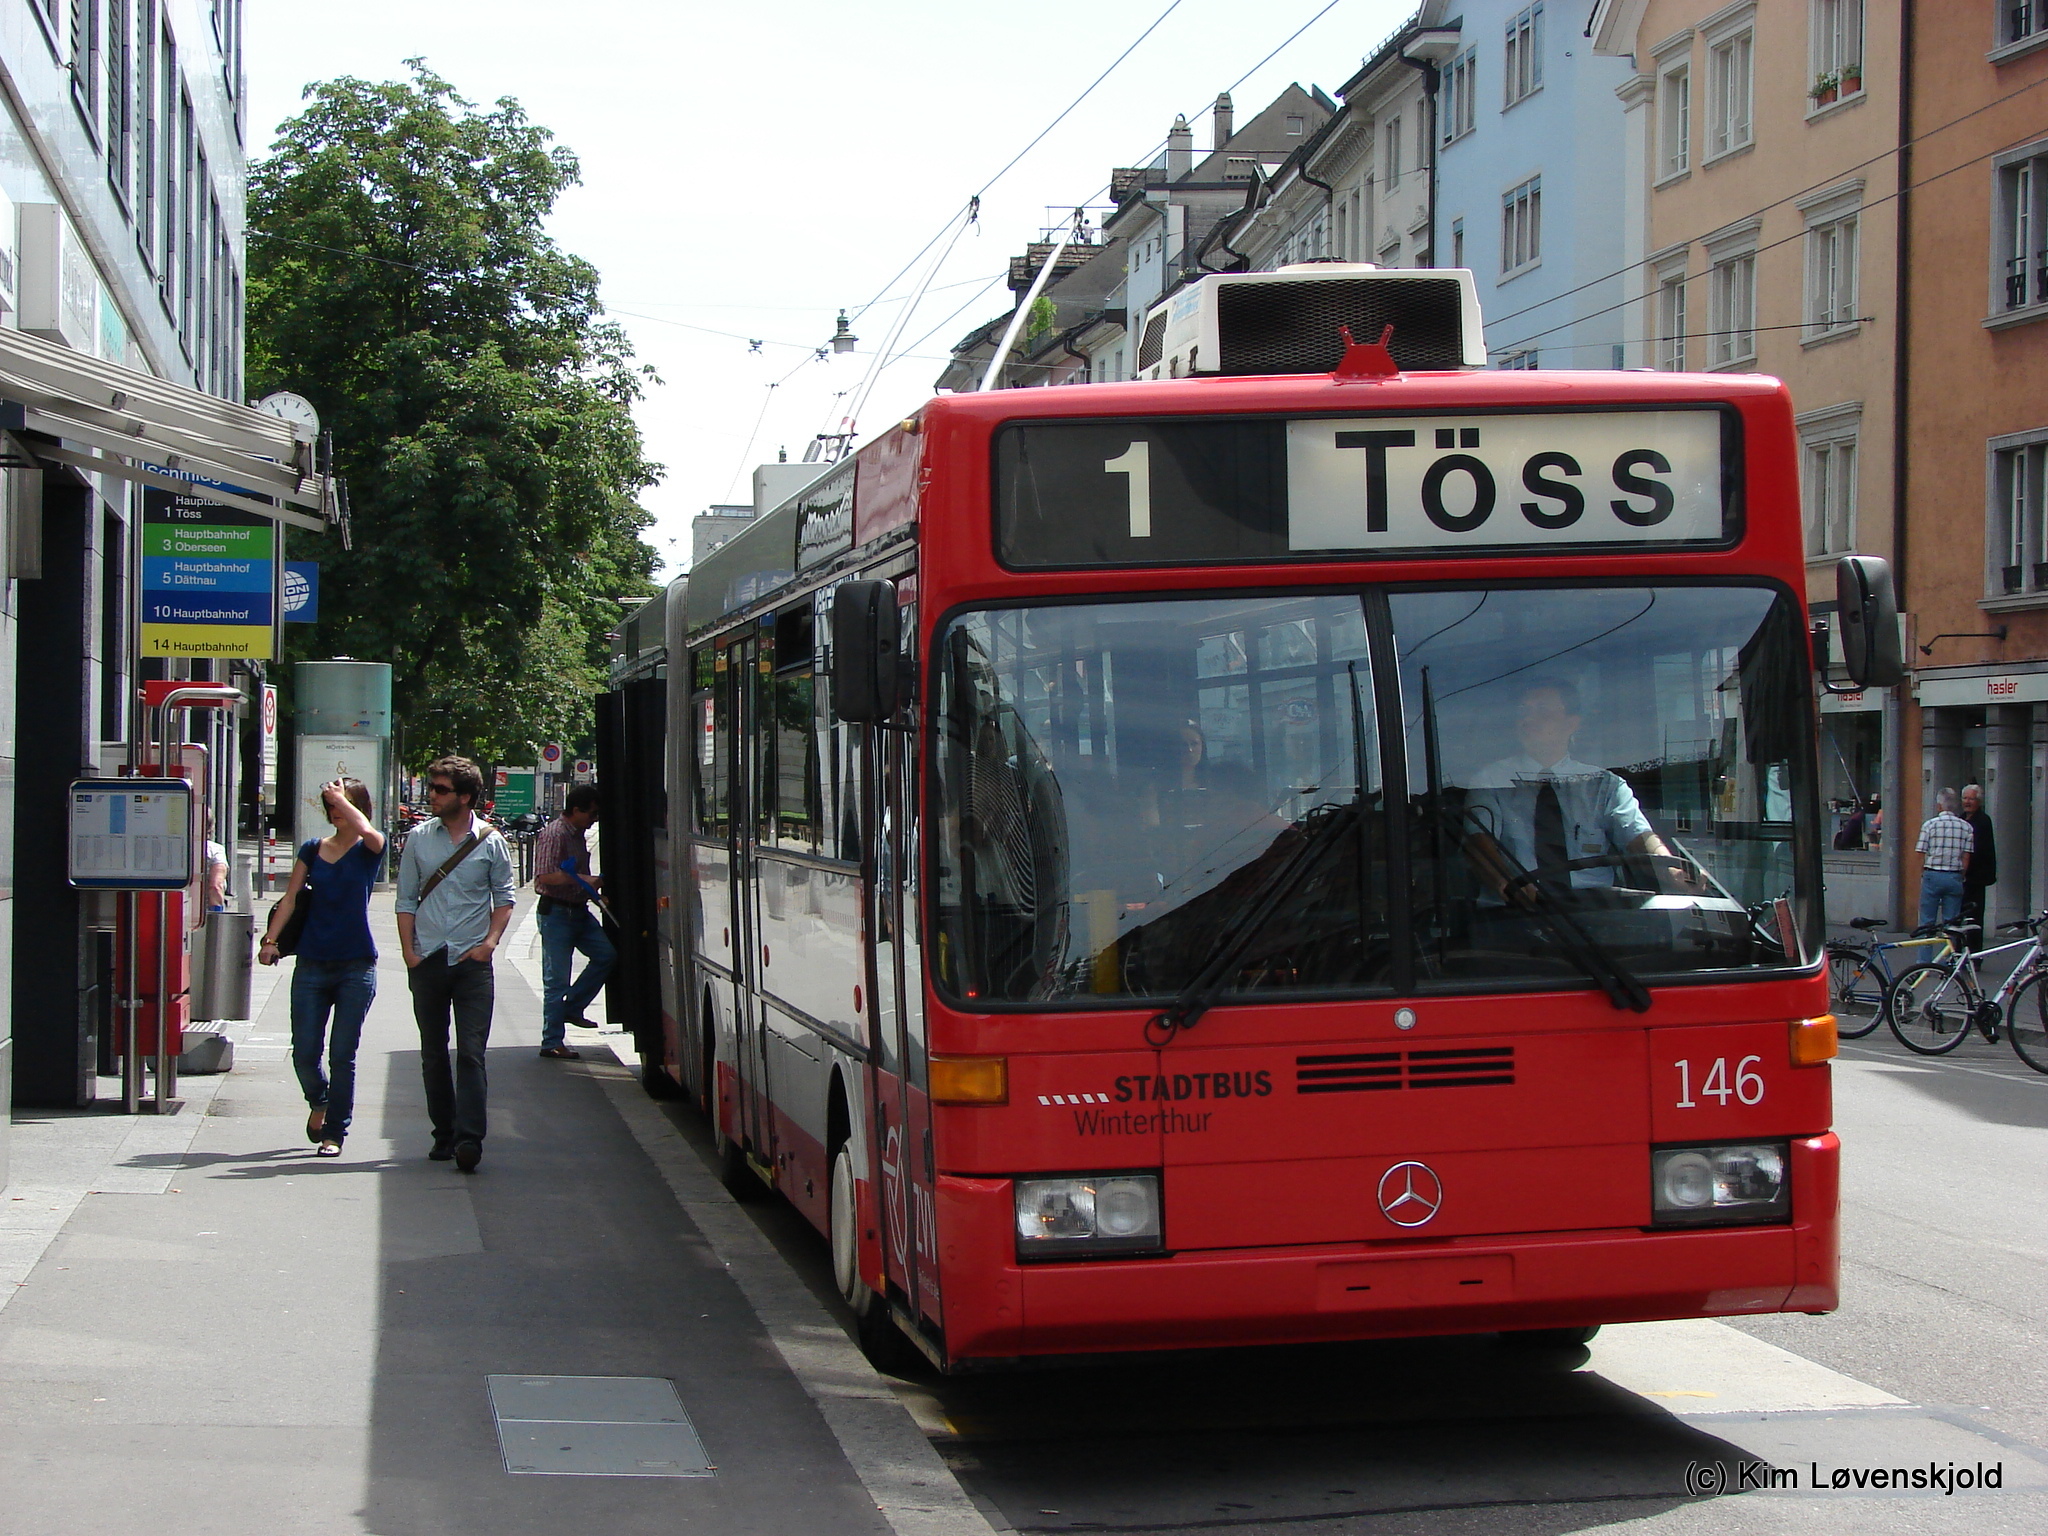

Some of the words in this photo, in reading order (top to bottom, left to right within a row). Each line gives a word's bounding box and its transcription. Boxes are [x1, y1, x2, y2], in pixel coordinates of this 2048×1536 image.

[1104, 441, 1151, 538] 1
[164, 506, 171, 518] 1
[175, 508, 202, 519] Töss
[174, 529, 250, 541] Hauptbahnhof
[163, 539, 172, 551] 3
[175, 541, 227, 552] Oberseen
[174, 561, 250, 573] Hauptbahnhof
[162, 572, 171, 584] 5
[174, 574, 217, 586] Dättnau
[286, 584, 310, 595] ONI
[153, 606, 171, 618] 10
[173, 608, 250, 620] Hauptbahnhof
[153, 639, 170, 650] 14
[173, 641, 249, 654] Hauptbahnhof
[1987, 678, 2019, 695] hasler
[1114, 1069, 1273, 1103] STADTBUS
[1674, 1054, 1765, 1108] 146
[1073, 1107, 1213, 1137] Winterthur
